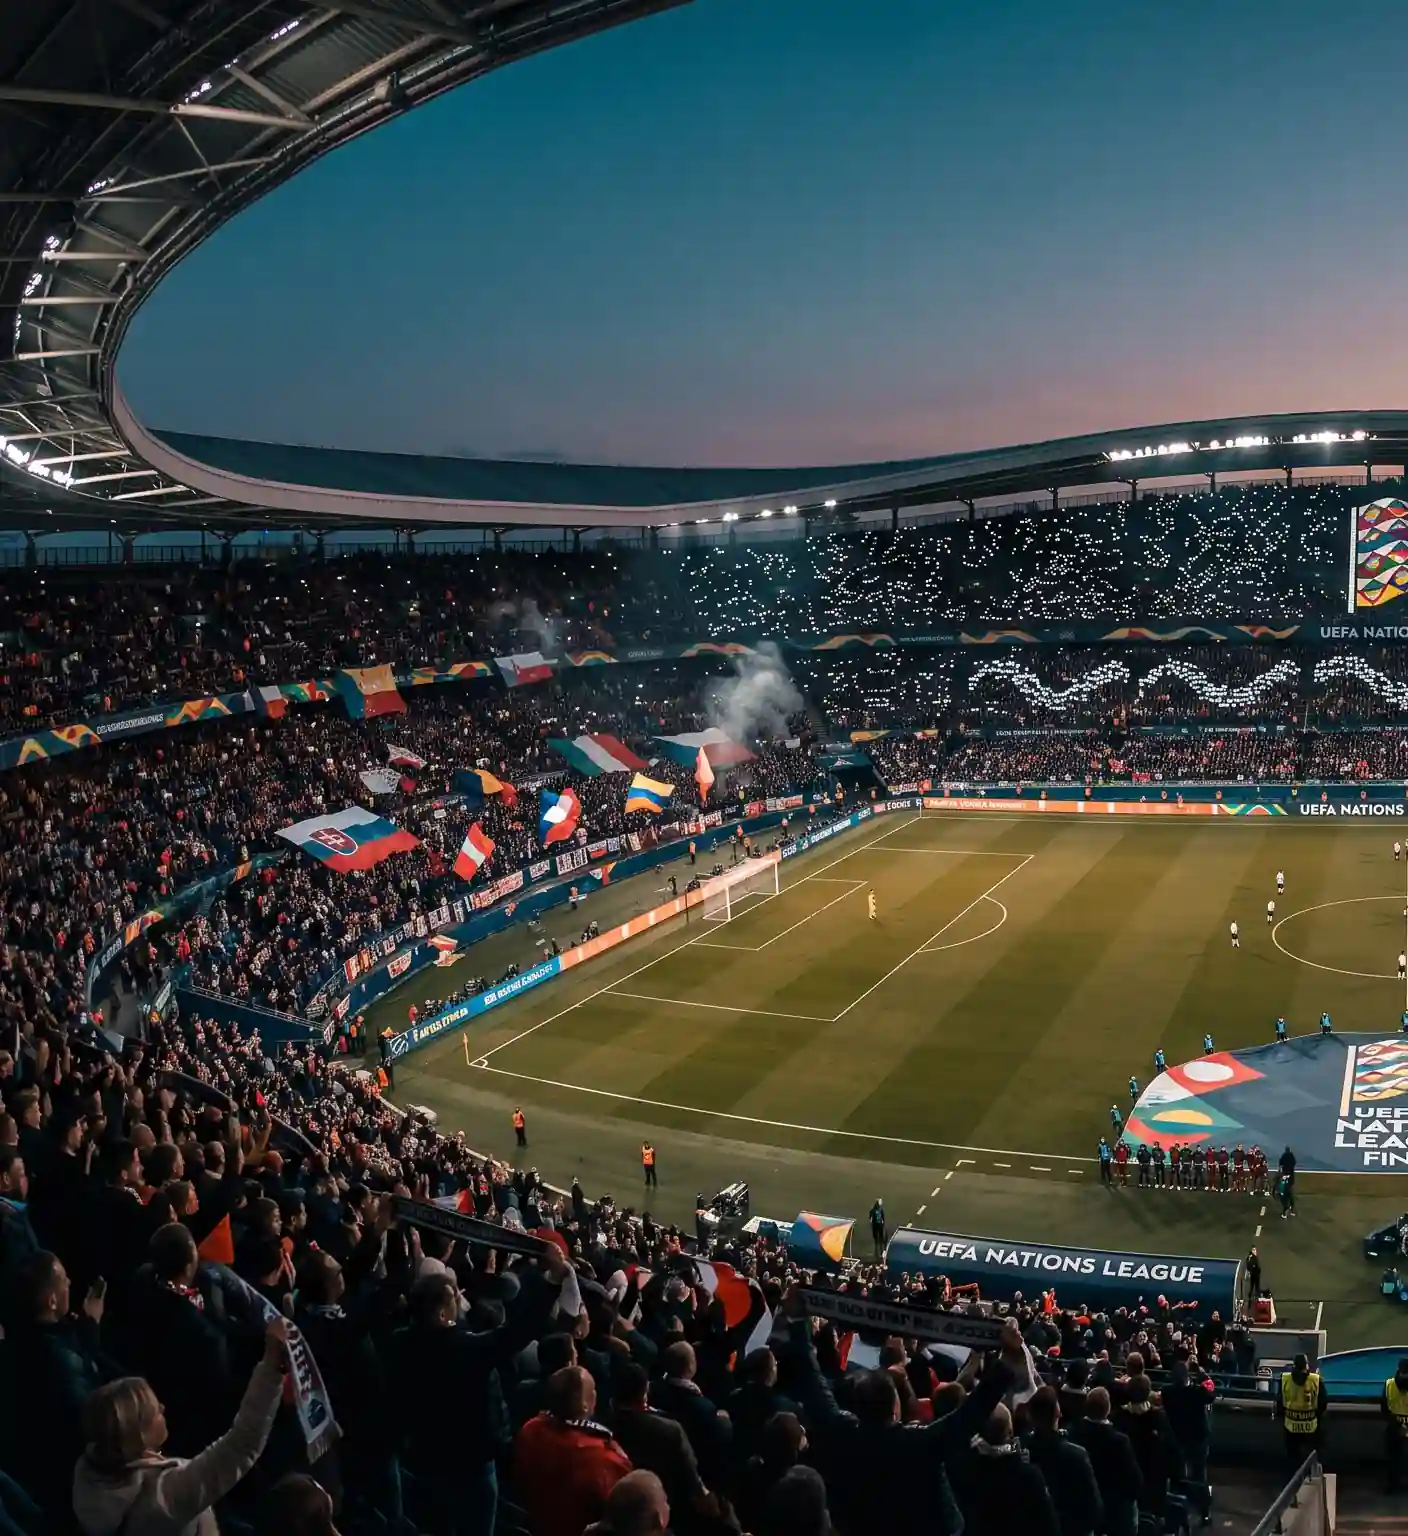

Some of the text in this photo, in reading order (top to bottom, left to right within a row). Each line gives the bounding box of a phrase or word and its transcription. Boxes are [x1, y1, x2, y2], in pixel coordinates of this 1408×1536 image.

[1320, 626, 1359, 638] UEFA
[1300, 803, 1337, 816] UEFA
[1340, 803, 1405, 816] NATIONS
[918, 1239, 1204, 1283] UEFA NATIONS LEAGUE
